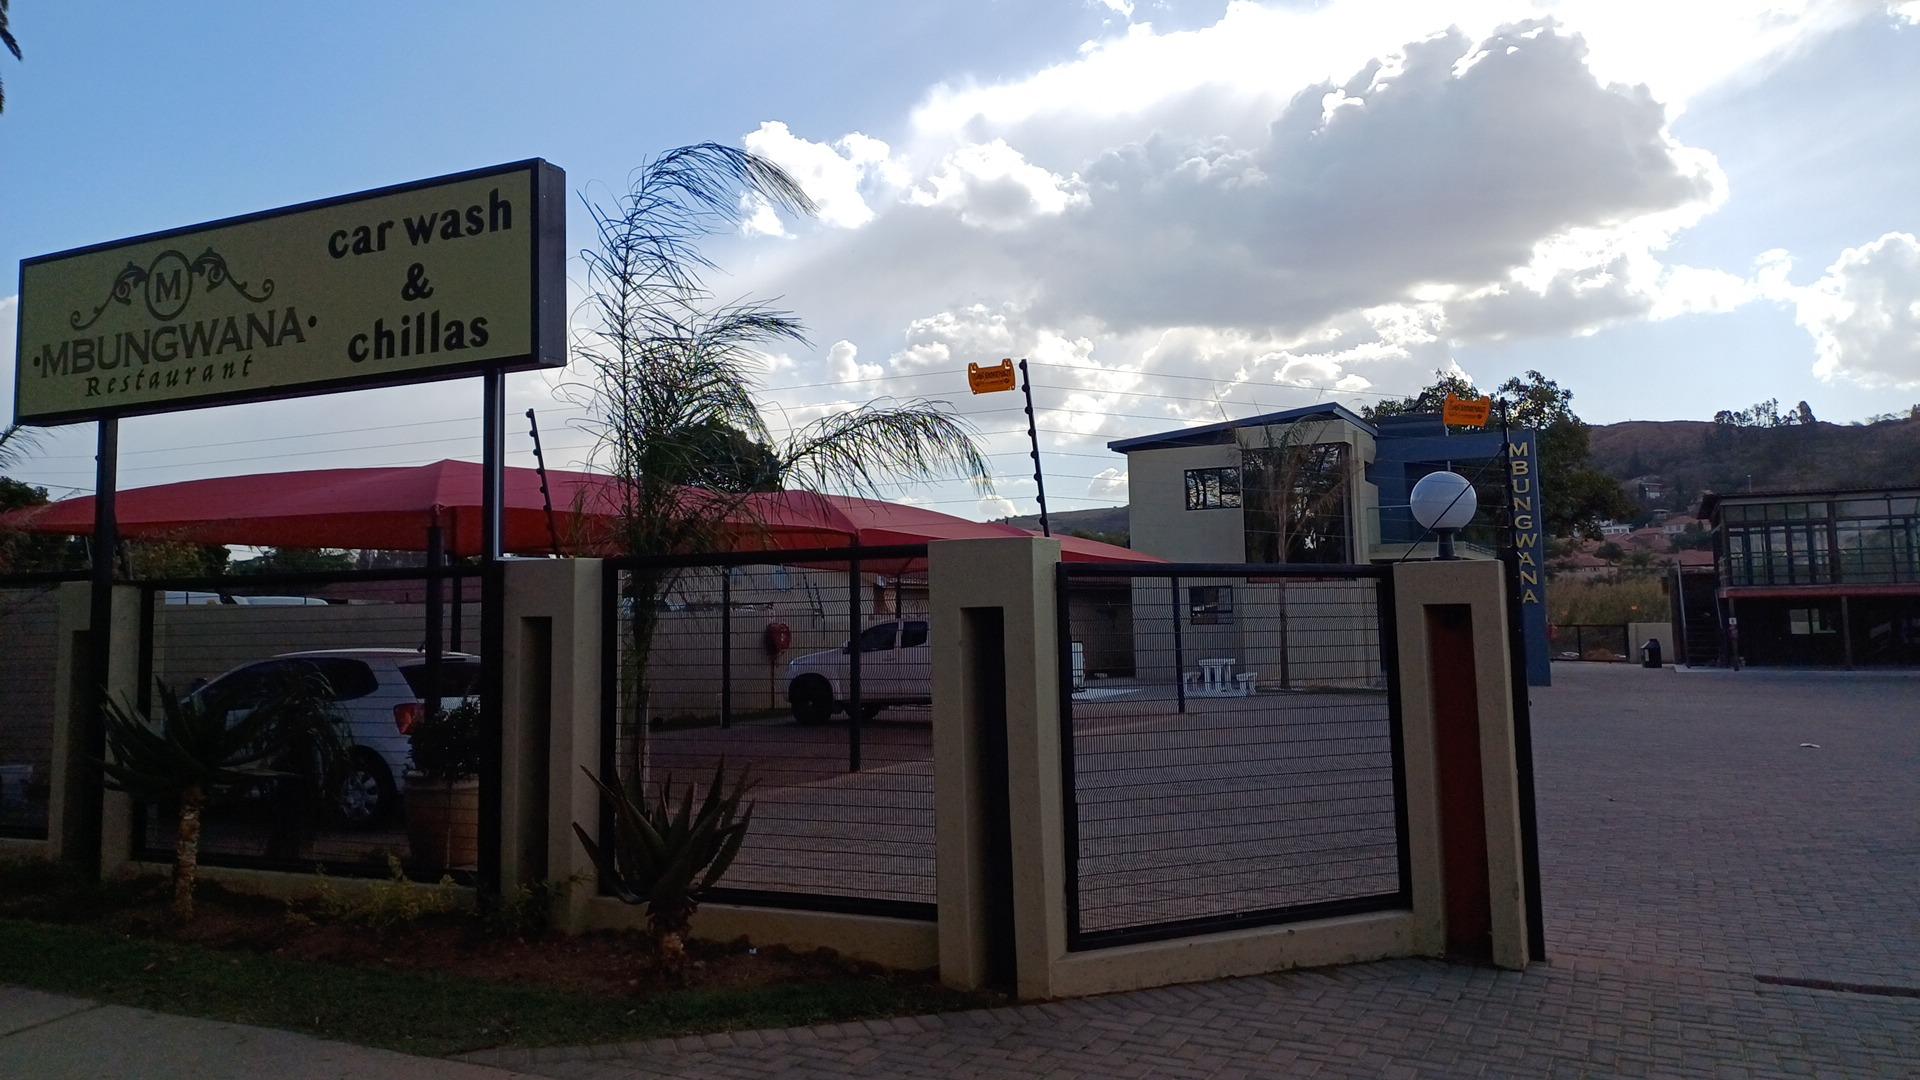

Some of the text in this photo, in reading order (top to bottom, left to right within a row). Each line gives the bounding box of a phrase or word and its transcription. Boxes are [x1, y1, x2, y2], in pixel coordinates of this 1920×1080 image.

[328, 188, 512, 258] car wash
[155, 269, 181, 303] M
[402, 262, 434, 301] &
[41, 308, 306, 378] MBUNGWANA
[347, 311, 489, 362] chillas
[85, 355, 254, 397] Restaurant
[1509, 442, 1538, 603] MBUNGWANA
